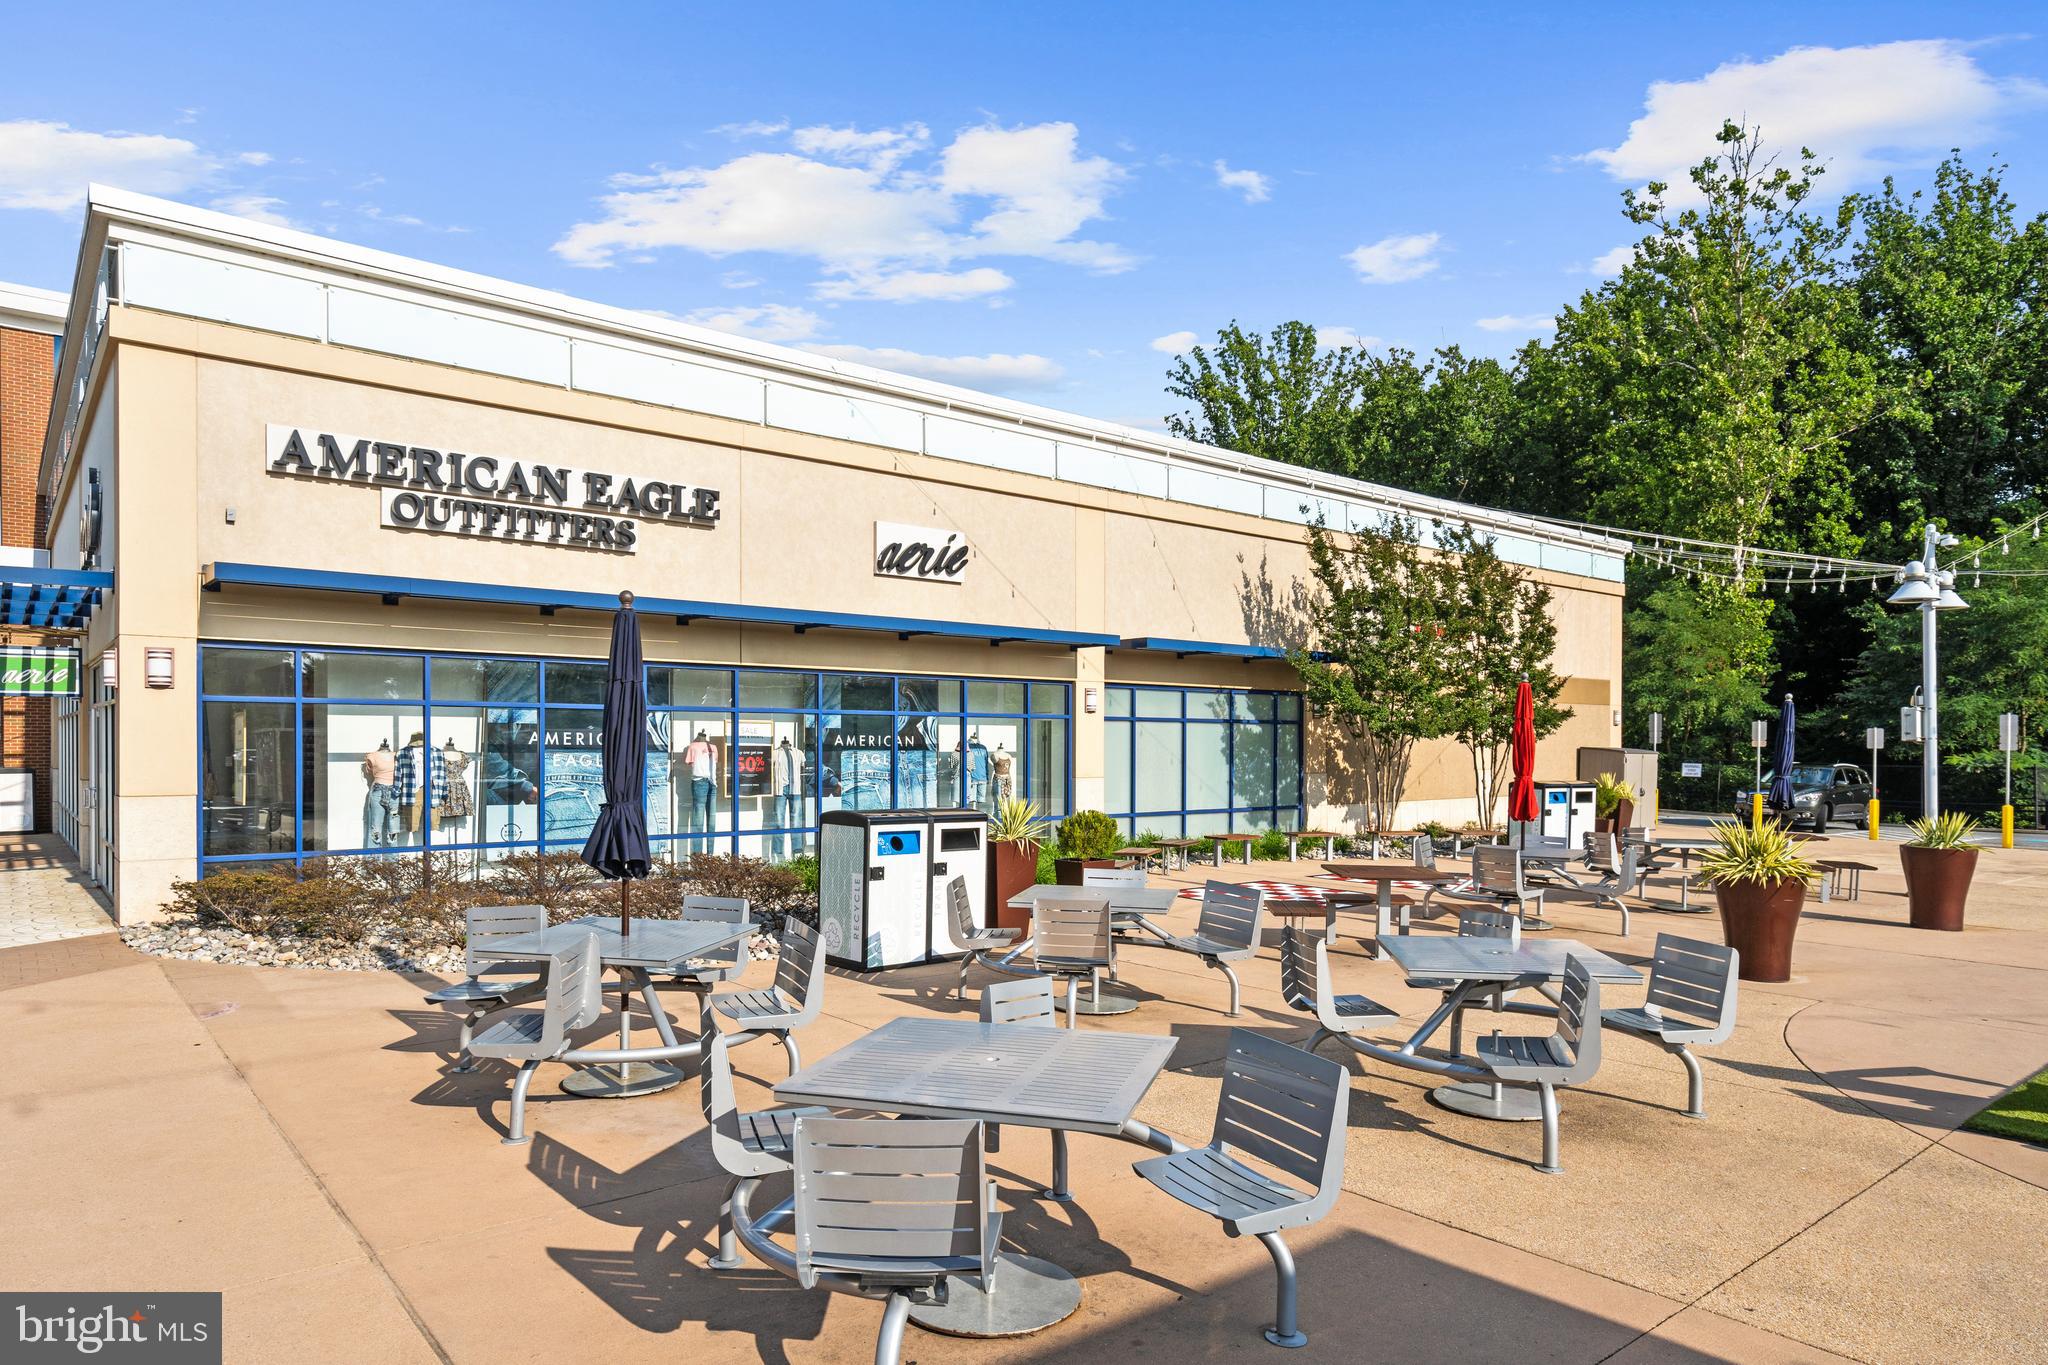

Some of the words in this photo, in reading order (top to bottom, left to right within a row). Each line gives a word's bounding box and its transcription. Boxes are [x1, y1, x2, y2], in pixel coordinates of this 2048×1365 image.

[272, 428, 572, 504] AMERICAN
[583, 471, 721, 522] EAGLE
[390, 492, 637, 547] OUTFITTERS
[876, 533, 969, 577] aerie
[1, 663, 69, 685] aerie
[528, 731, 603, 746] AMERIC
[834, 734, 915, 747] AMERICAN
[552, 753, 603, 768] EAGL
[851, 752, 890, 766] EAGL
[853, 878, 861, 940] RECYCLE
